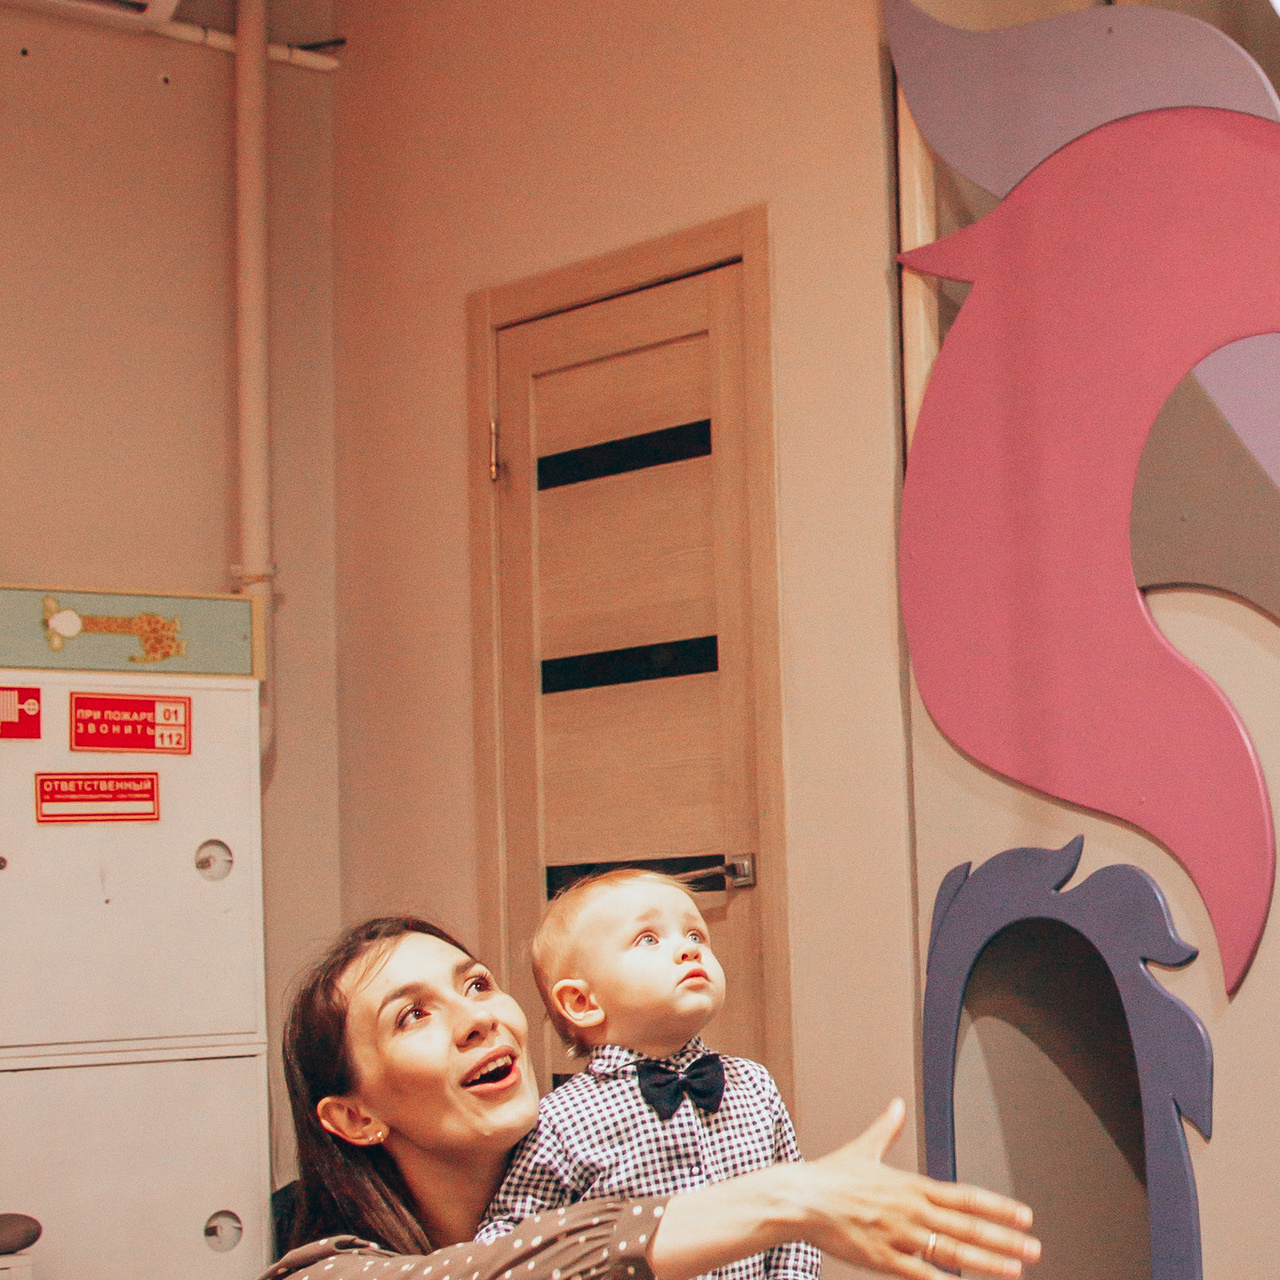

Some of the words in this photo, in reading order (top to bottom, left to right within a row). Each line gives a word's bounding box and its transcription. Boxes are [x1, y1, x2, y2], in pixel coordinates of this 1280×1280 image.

[76, 708, 101, 720] ПРИ
[103, 710, 154, 722] ПОЖАРЕ
[163, 708, 179, 721] 01
[76, 722, 155, 735] ЗВОНИТЬ
[159, 732, 183, 746] 112
[43, 779, 152, 792] ОТВЕТСТВЕННЫЙ
